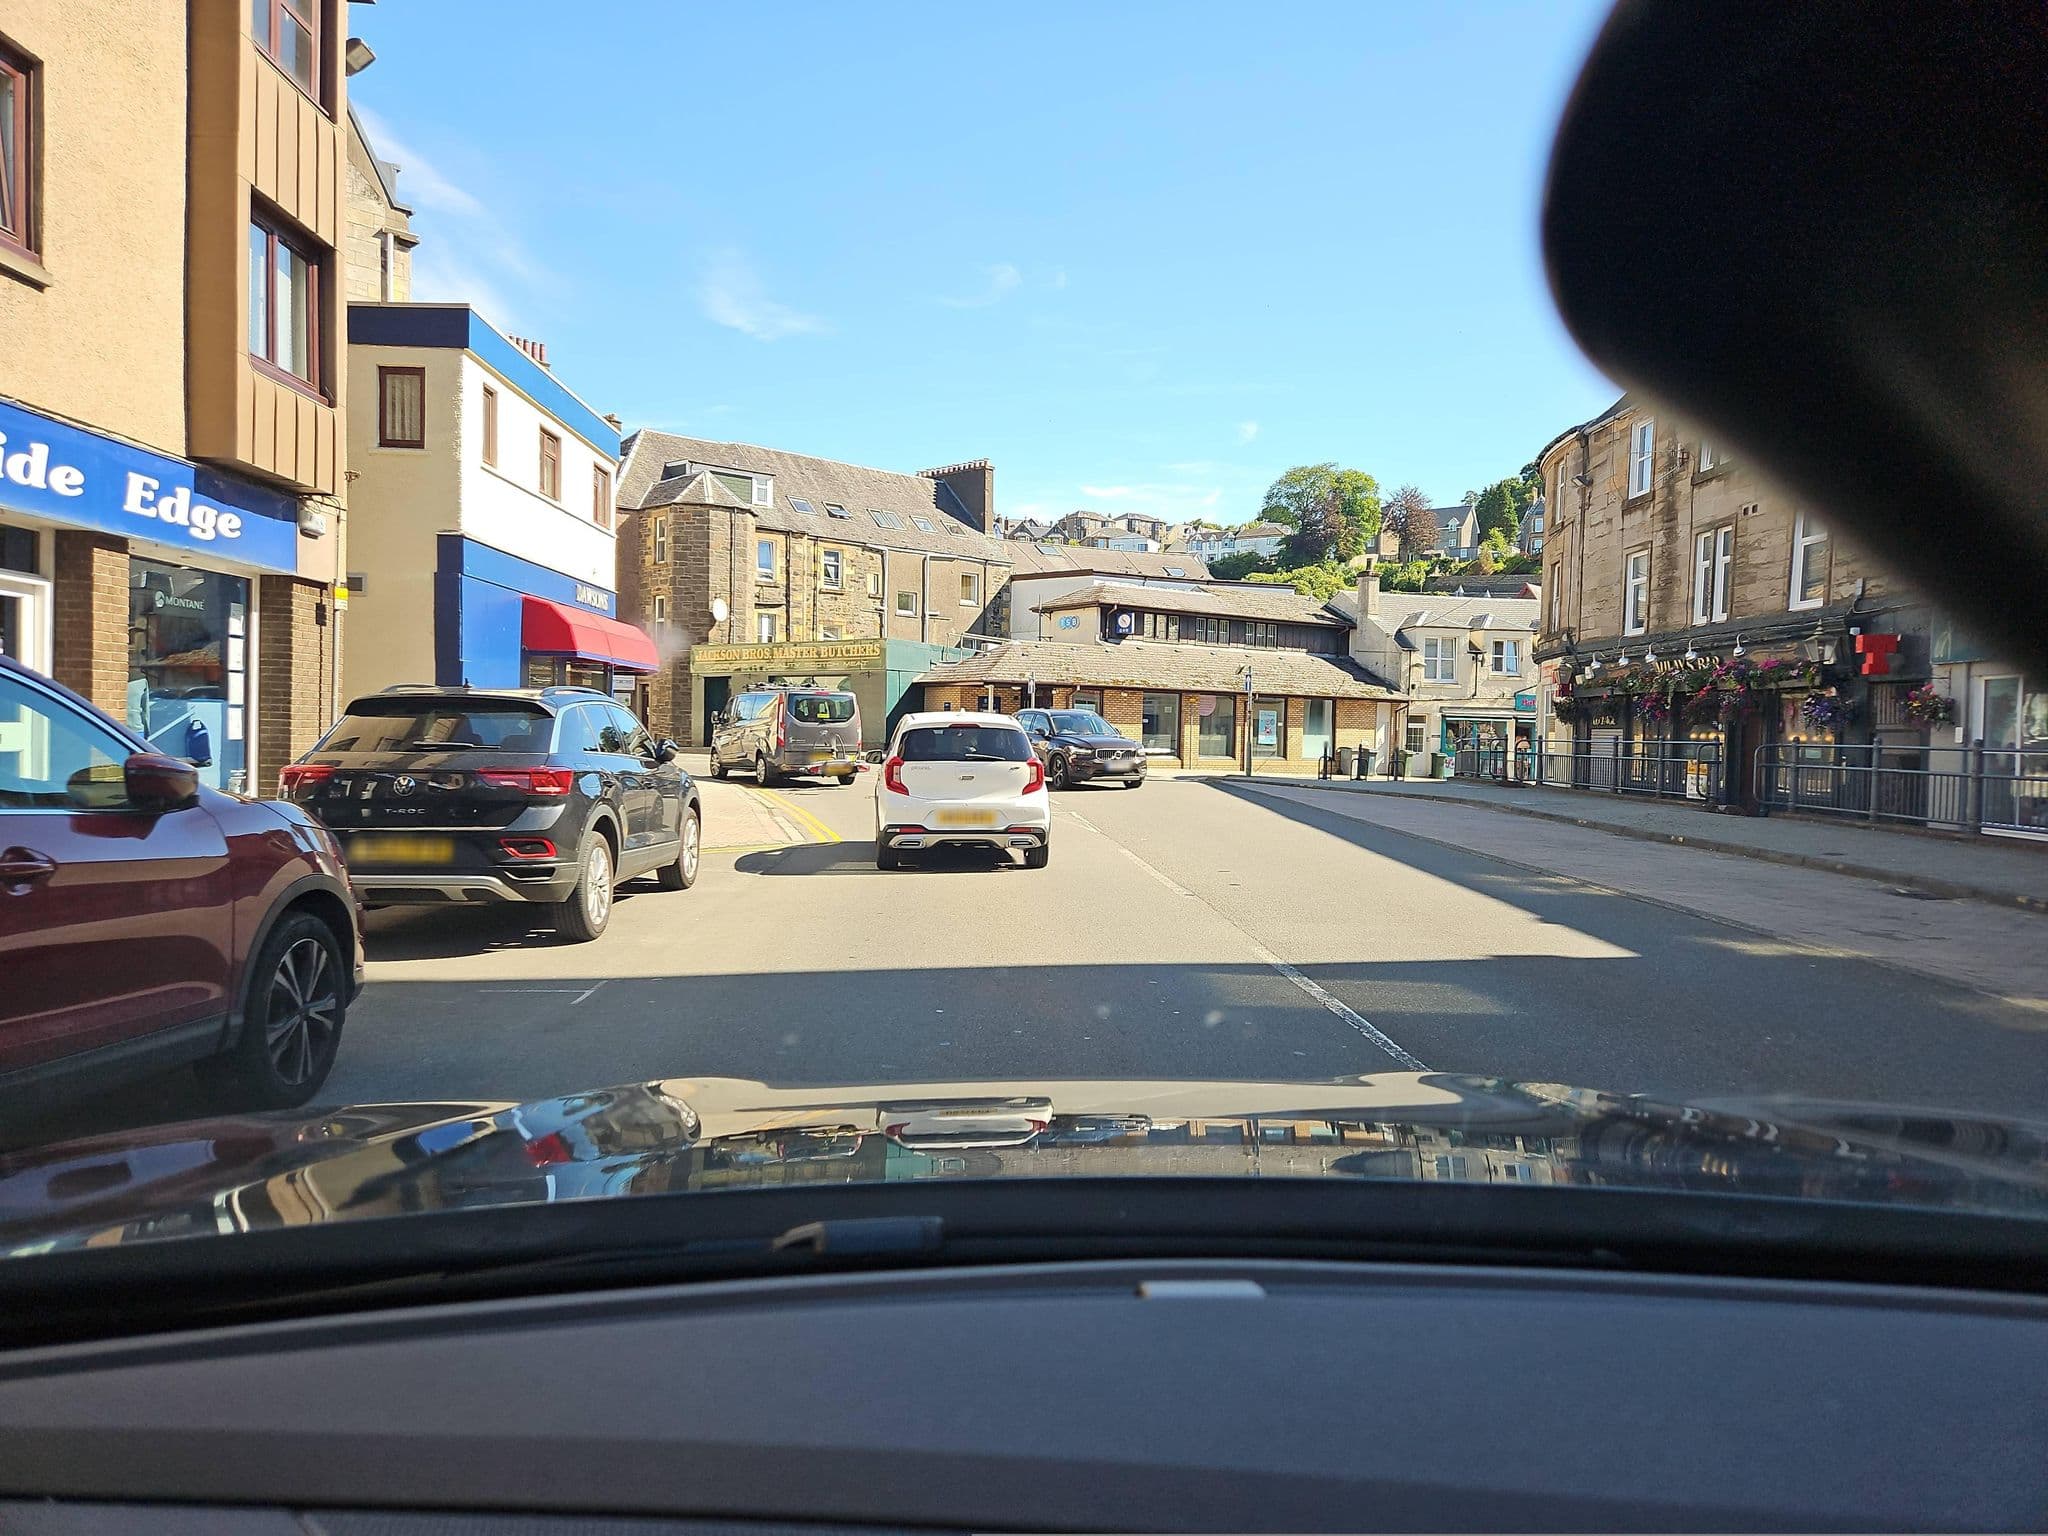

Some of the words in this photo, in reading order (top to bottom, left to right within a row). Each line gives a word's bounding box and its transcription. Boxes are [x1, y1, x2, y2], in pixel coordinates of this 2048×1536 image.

[123, 471, 242, 541] Edge
[165, 596, 205, 611] MONTANE
[695, 649, 740, 662] JACKSON
[773, 646, 819, 660] MASTER
[821, 643, 881, 658] BUTCHERS
